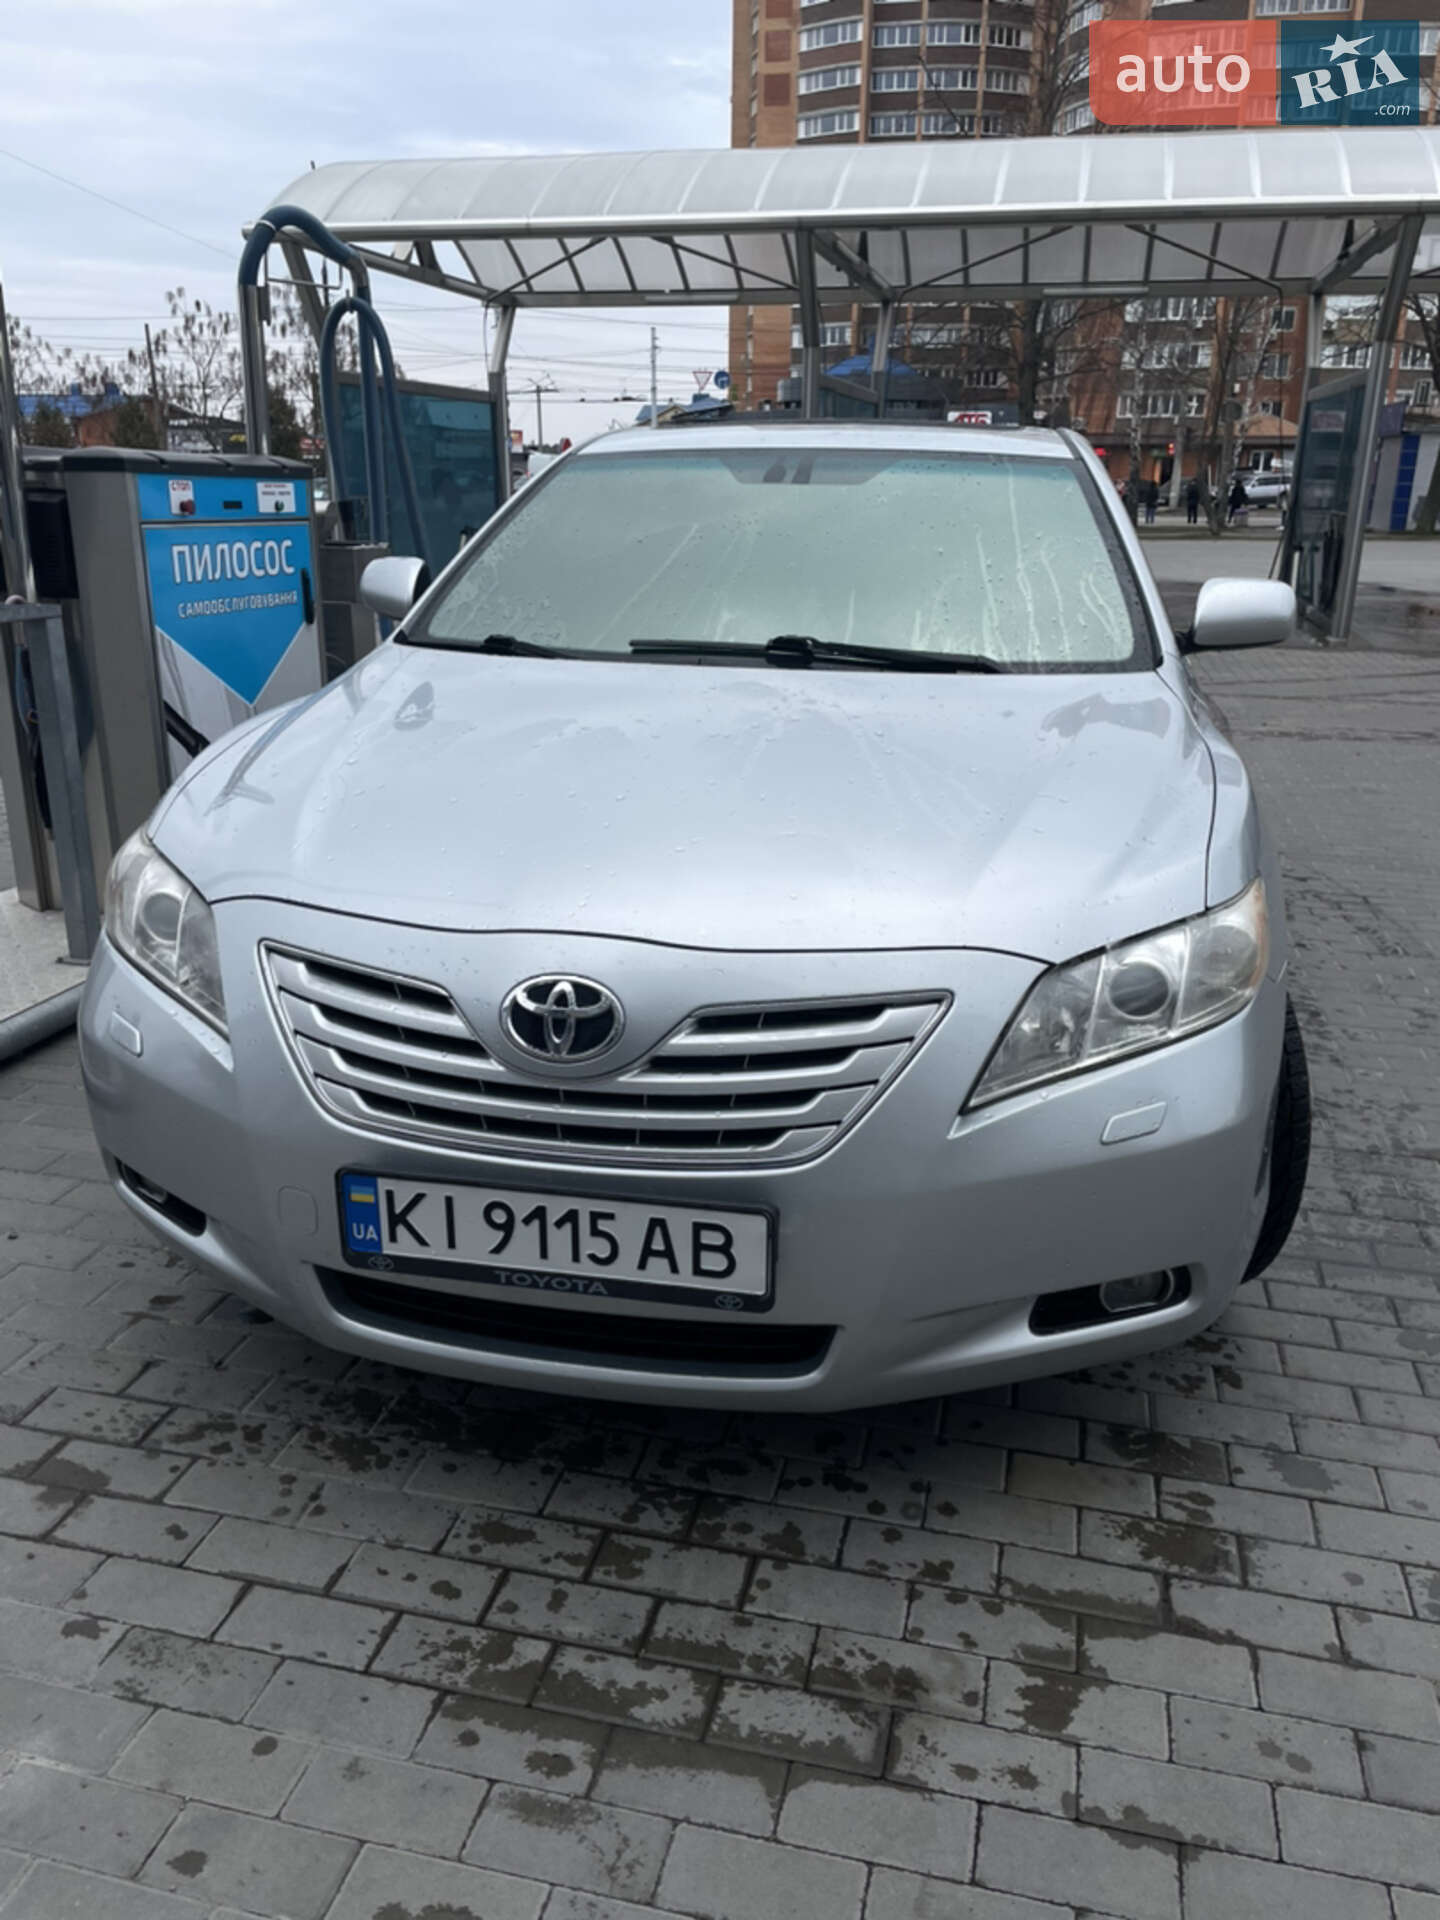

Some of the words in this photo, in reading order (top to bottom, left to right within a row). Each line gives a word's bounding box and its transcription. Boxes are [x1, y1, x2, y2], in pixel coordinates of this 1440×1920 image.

[171, 539, 295, 583] ПИЛОСОС
[352, 1222, 379, 1242] UA
[494, 1269, 609, 1296] TOYOTA
